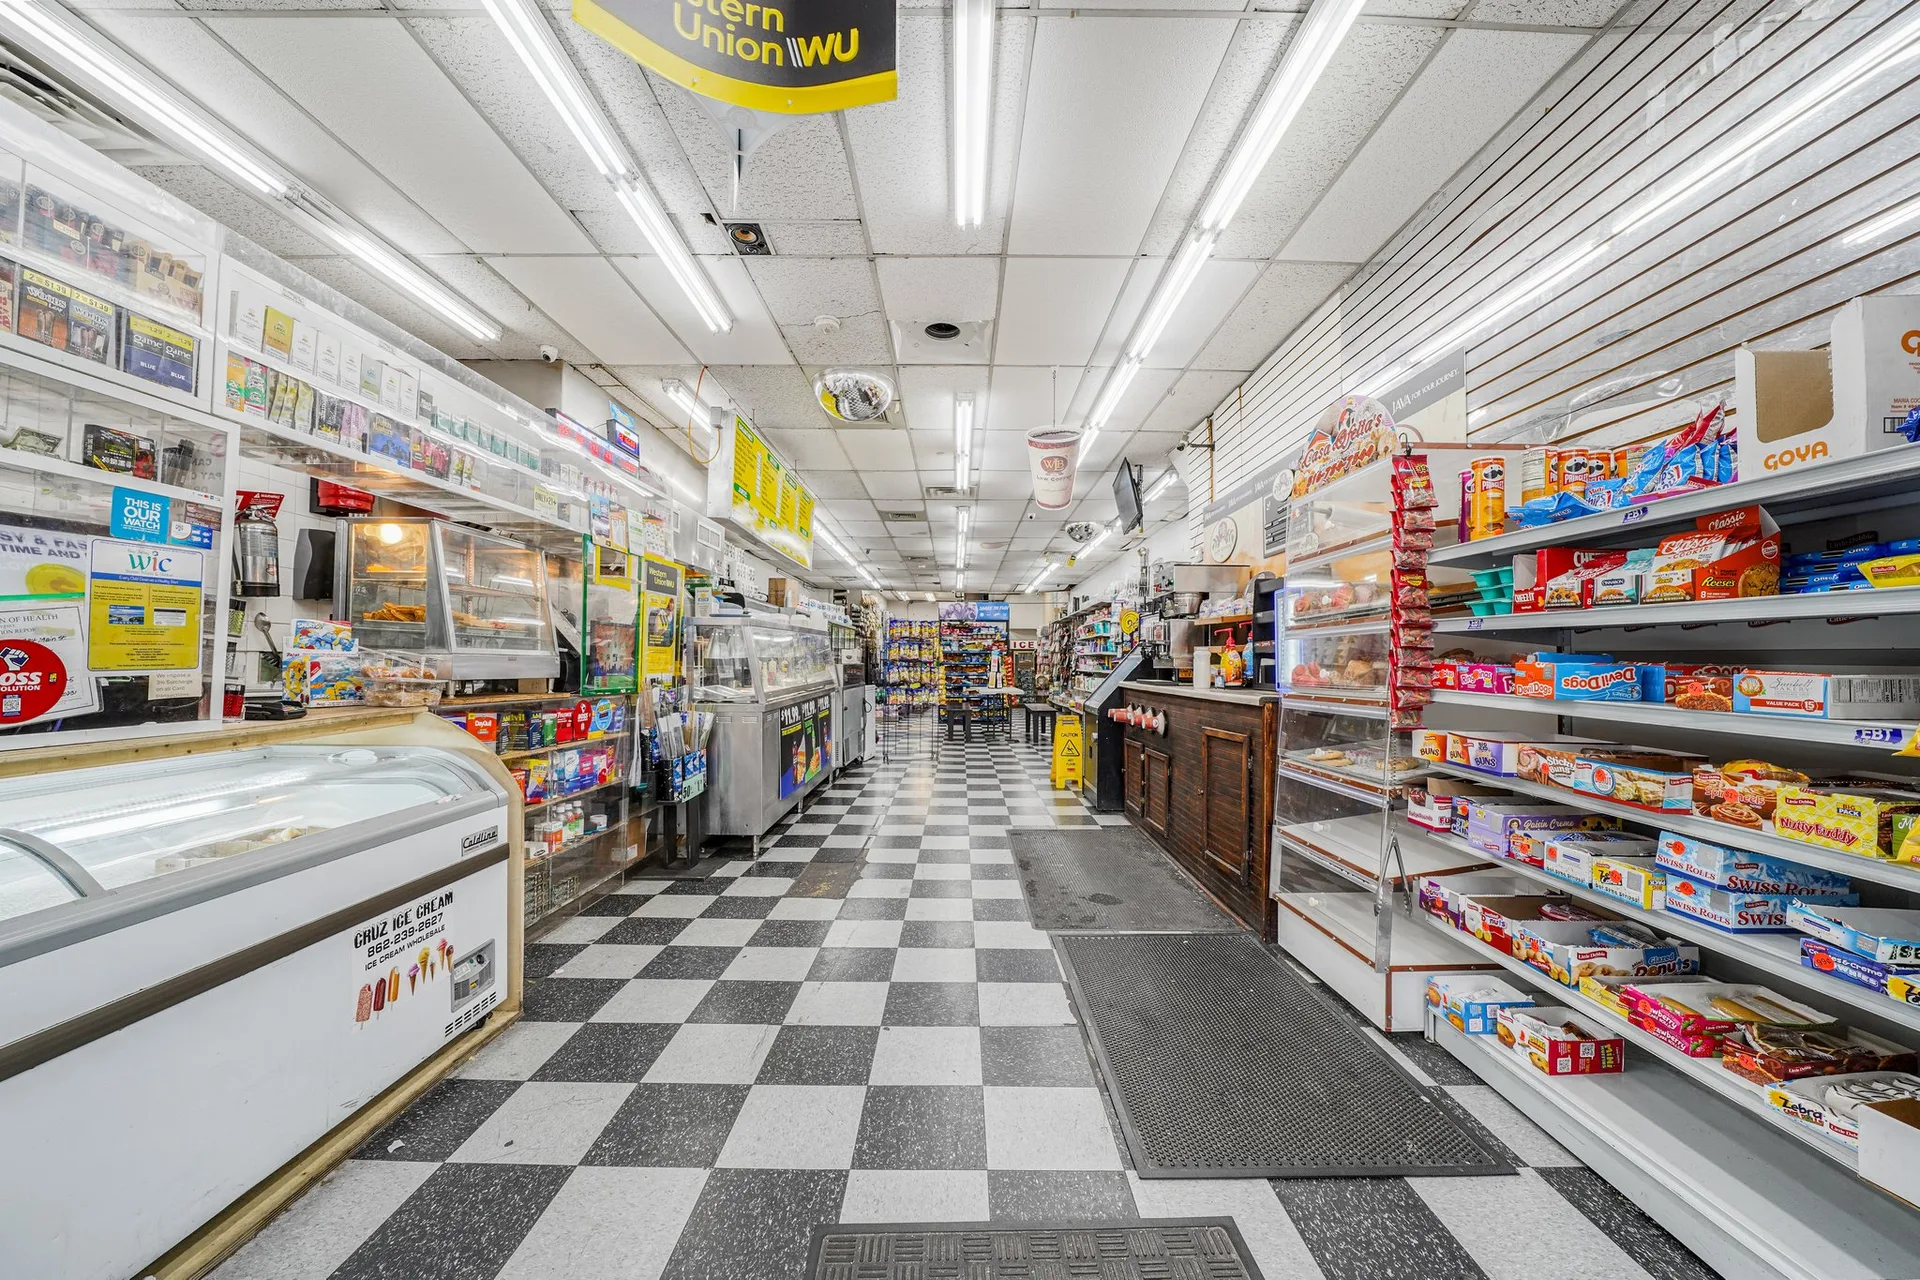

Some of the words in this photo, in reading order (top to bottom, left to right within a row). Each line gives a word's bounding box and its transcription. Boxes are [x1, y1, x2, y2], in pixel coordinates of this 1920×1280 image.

[673, 1, 784, 67] Union
[797, 27, 859, 67] WU
[132, 333, 163, 349] game
[165, 344, 191, 360] game
[139, 361, 156, 371] BLUE
[170, 371, 186, 381] BLUE
[1392, 393, 1412, 415] JAVA
[1411, 390, 1422, 400] FOR
[1421, 382, 1435, 397] YOUR
[1302, 444, 1331, 469] Casa
[1763, 440, 1829, 471] GOYA
[124, 497, 149, 509] THIS
[151, 501, 162, 511] IS
[123, 506, 161, 523] OUR
[1708, 510, 1746, 531] Classic
[123, 517, 160, 530] WATCH
[1662, 533, 1725, 555] Classic
[47, 549, 80, 559] AND
[1701, 577, 1735, 588] Reese's
[1701, 591, 1706, 599] 8
[9, 616, 21, 624] OF
[23, 613, 58, 622] HEALTH
[1013, 641, 1034, 649] ICE
[1561, 673, 1601, 691] Dogs
[1600, 667, 1637, 689] Devil
[1534, 681, 1553, 696] Dogs
[1804, 700, 1815, 710] 15
[1861, 728, 1893, 743] EBT
[1420, 747, 1440, 757] BUNS
[1474, 757, 1496, 767] BUNS
[1838, 809, 1861, 818] PACK
[1842, 803, 1856, 811] BIG
[1780, 817, 1814, 836] Nutty
[1814, 823, 1858, 846] Buddy
[1657, 854, 1685, 870] SWISS
[1685, 862, 1716, 882] ROLLS
[1727, 875, 1781, 895] SWISS
[1668, 896, 1698, 915] SWISS
[1699, 906, 1731, 926] ROLLS
[1737, 910, 1786, 927] SWIS
[354, 920, 388, 949] CRUZ
[392, 908, 412, 931] ICE
[415, 891, 454, 920] CREAM
[1481, 914, 1507, 928] Dnuts
[365, 958, 378, 971] ICE
[379, 945, 406, 964] CREAM
[406, 924, 446, 951] WHOLESALE
[1648, 952, 1676, 964] Glazed
[1634, 957, 1692, 977] Donuts
[1779, 1096, 1824, 1120] Zebra
